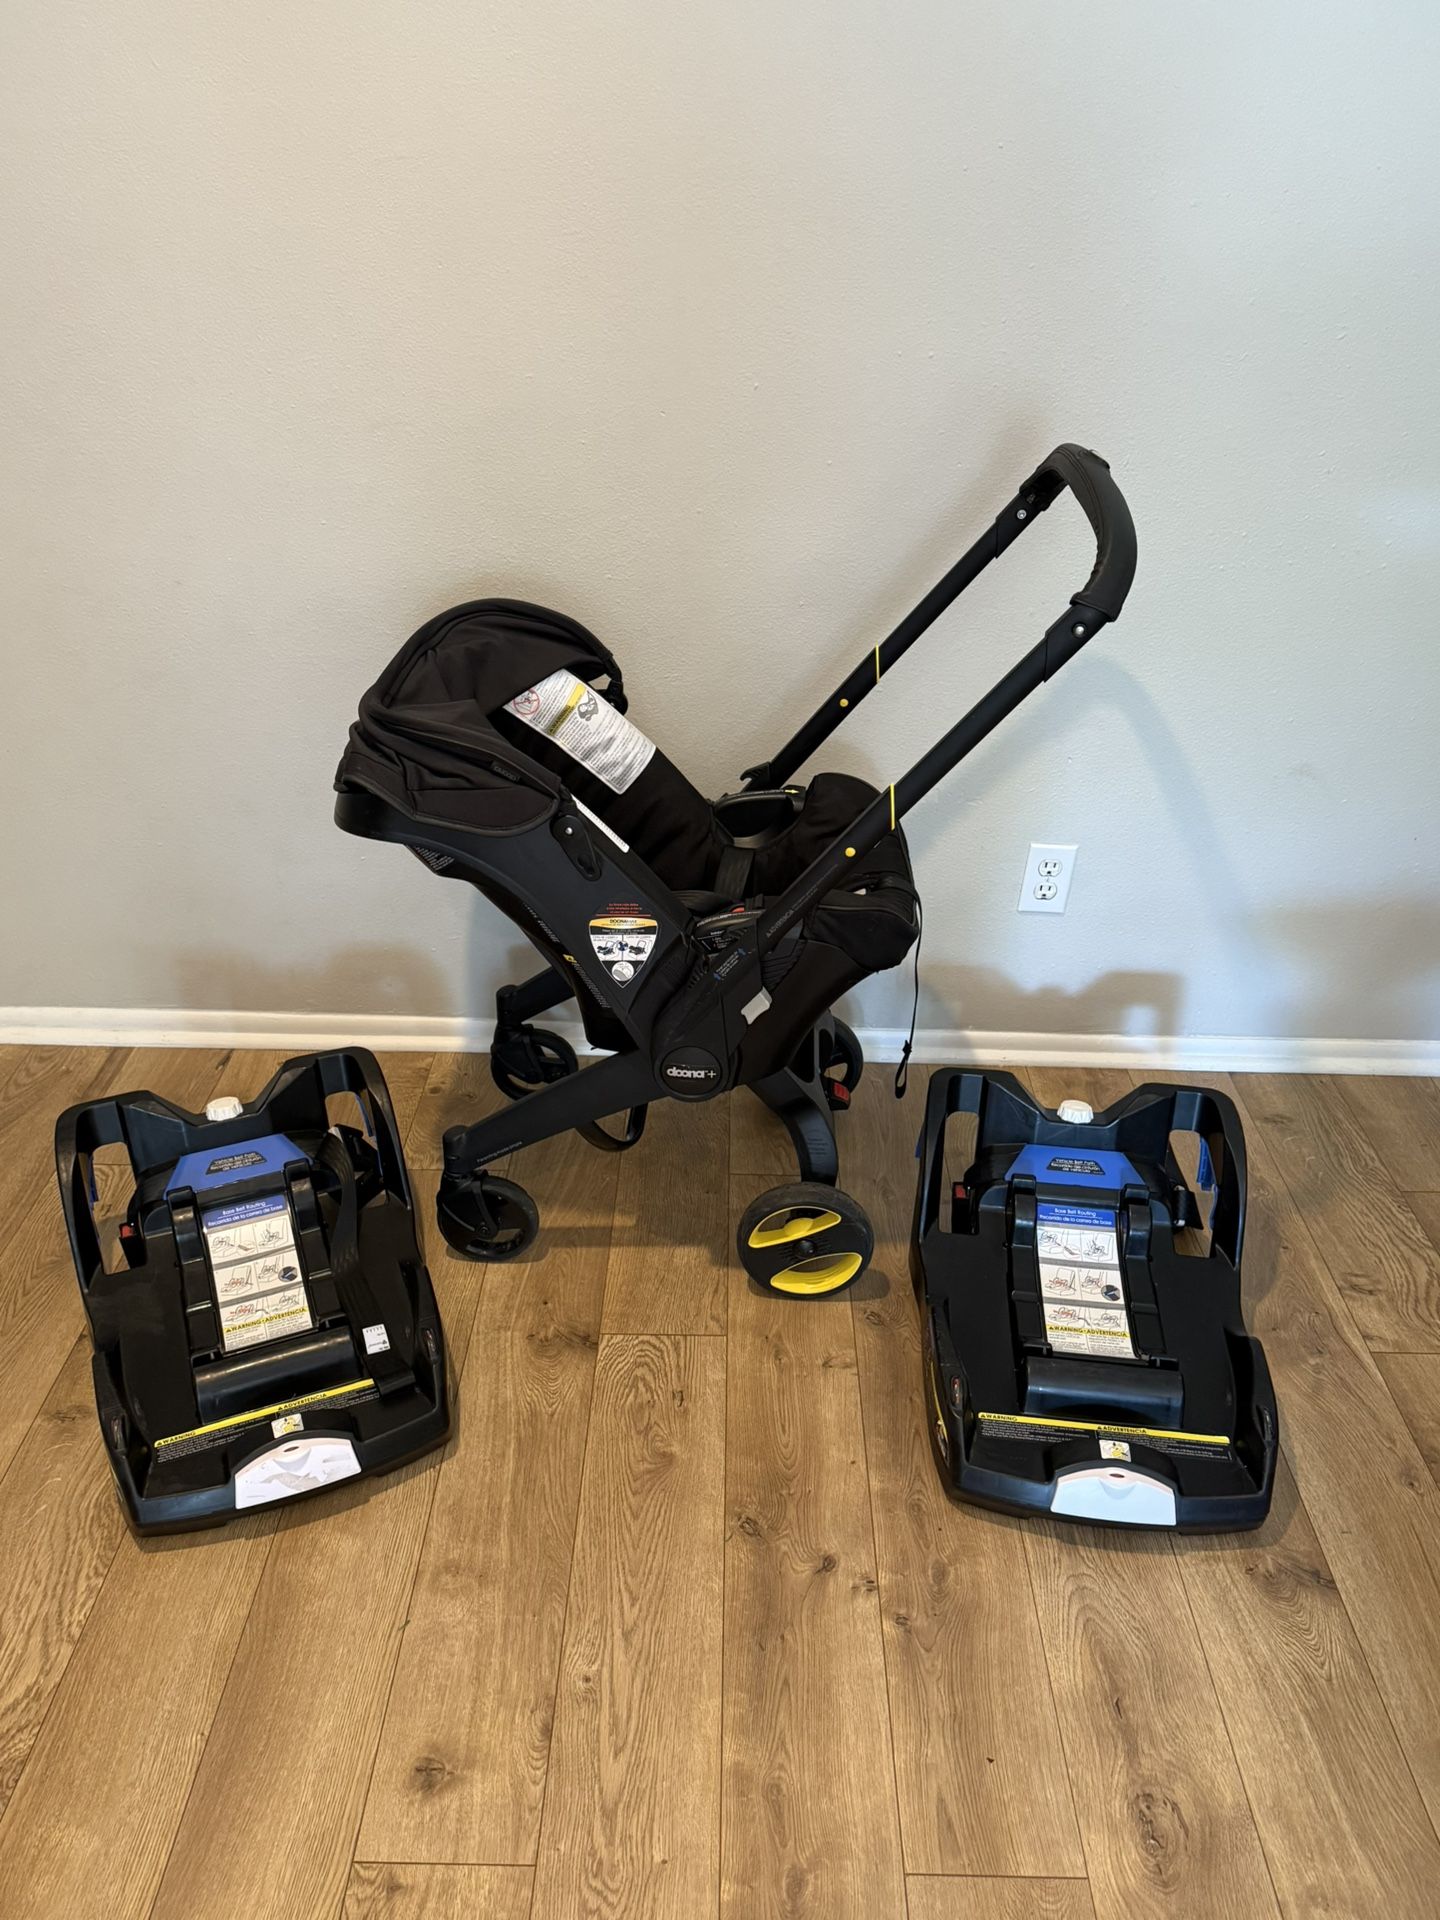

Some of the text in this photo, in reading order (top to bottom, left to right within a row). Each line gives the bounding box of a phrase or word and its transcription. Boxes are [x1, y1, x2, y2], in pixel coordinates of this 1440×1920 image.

[246, 1201, 266, 1209] Routing
[232, 1318, 262, 1332] WARNING
[265, 1307, 307, 1323] ADVERTENCIA
[1087, 1328, 1128, 1337] ADVERTENCIA
[284, 1393, 327, 1409] ADVERTENCIA
[987, 1414, 1018, 1422] WARNING
[1103, 1425, 1147, 1434] ADVERTENCIA
[163, 1431, 196, 1444] WARNING
